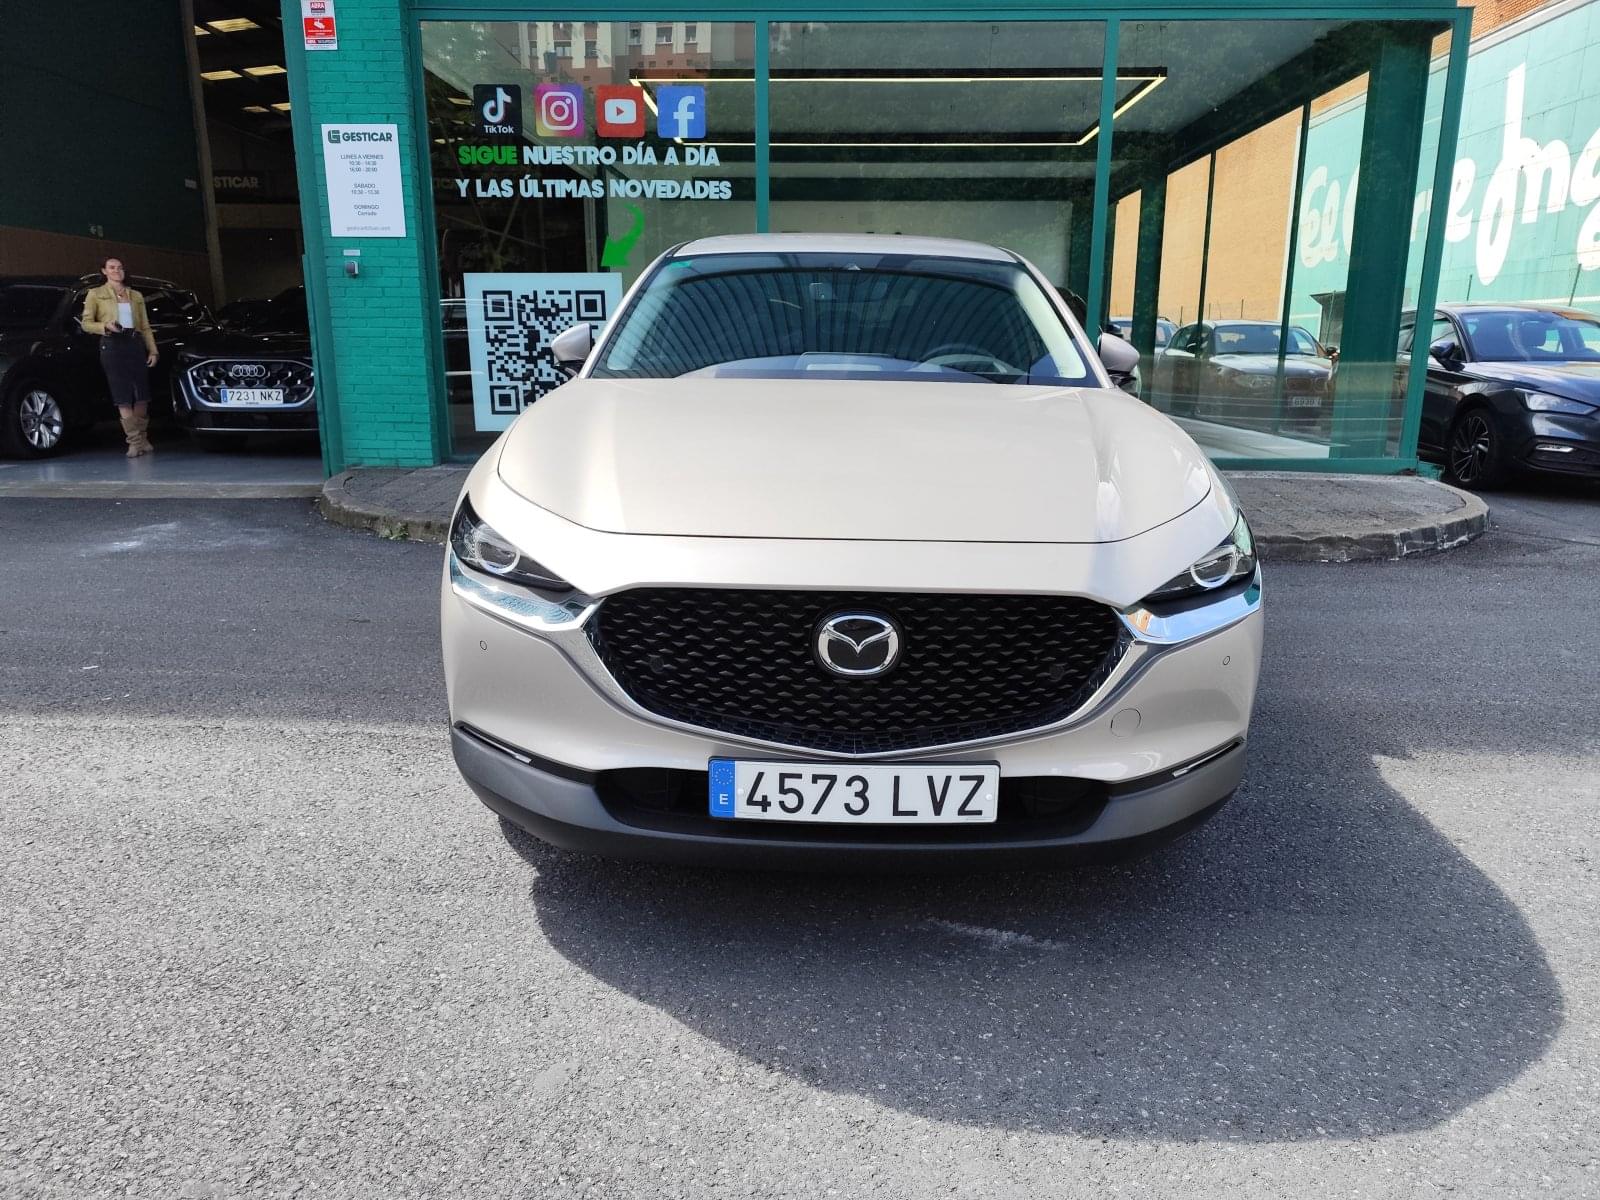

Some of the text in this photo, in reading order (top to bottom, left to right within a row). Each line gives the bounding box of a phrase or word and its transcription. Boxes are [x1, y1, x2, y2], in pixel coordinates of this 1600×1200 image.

[483, 124, 514, 135] TikTok
[342, 132, 393, 143] GESTICAR
[458, 141, 720, 168] SIGUE NUESTRO DÍA A DÍA
[214, 176, 258, 188] STICAR
[455, 178, 470, 199] Y
[476, 179, 514, 199] LAS
[519, 174, 605, 200] ÚLTIMAS
[609, 179, 732, 201] NOVEDADES
[228, 390, 282, 402] 7231 NKZ
[719, 771, 985, 817] E 4573 LVZ
